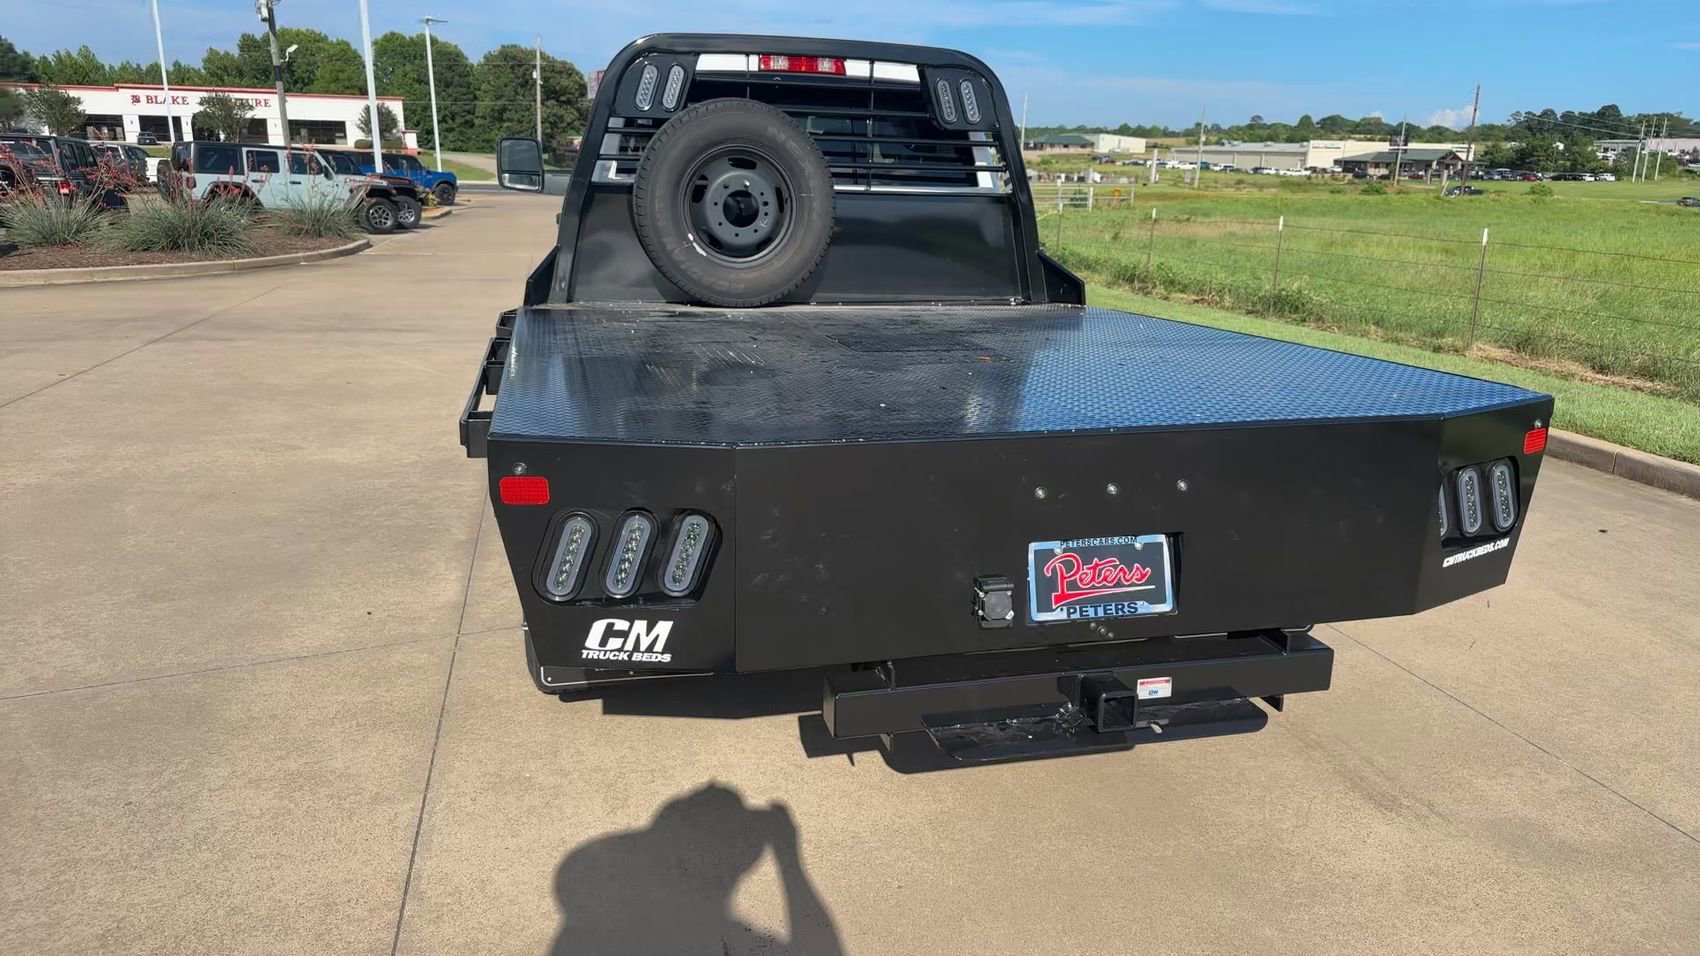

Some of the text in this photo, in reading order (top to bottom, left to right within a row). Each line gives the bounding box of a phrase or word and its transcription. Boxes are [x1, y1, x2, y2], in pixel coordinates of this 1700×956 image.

[1060, 536, 1138, 548] PETERSCARS.COM
[1044, 553, 1153, 600] Peters
[1066, 602, 1139, 619] PETERS
[584, 618, 674, 652] CM
[581, 649, 672, 662] TRUCK BEDS
